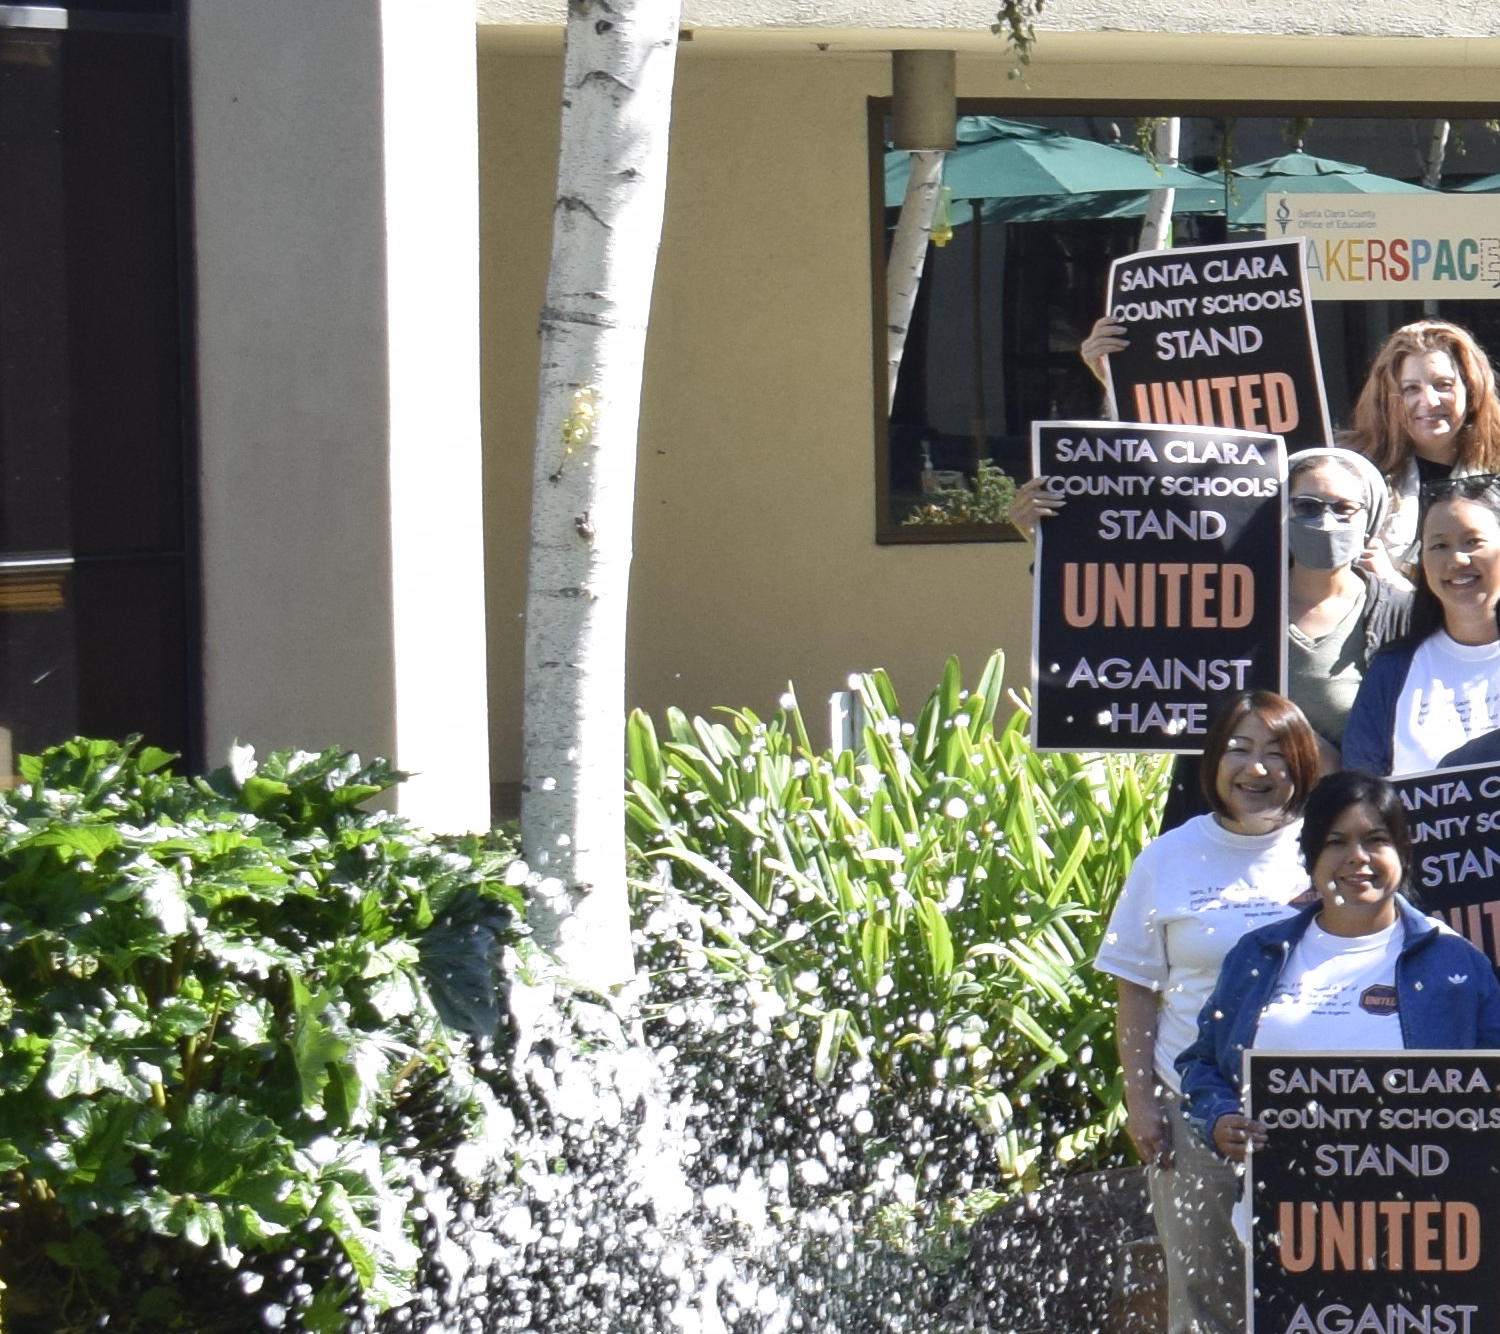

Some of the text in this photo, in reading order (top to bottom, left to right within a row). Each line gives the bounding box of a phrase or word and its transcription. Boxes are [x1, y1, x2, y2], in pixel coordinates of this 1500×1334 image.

[1121, 254, 1287, 292] SANTA CLARA
[1306, 238, 1500, 282] AKERSPACE
[1114, 288, 1302, 322] COUNTY SCHOOLS
[1157, 326, 1263, 360] STAND
[1056, 438, 1265, 465] SANTA CLARA
[1047, 476, 1278, 497] COUNTY SCHOOLS
[1098, 510, 1226, 541] STAND
[1063, 563, 1254, 628] UNITED
[1066, 658, 1252, 690] AGAINST
[1112, 703, 1207, 735] HATE
[1399, 783, 1472, 811] ANTA
[1268, 1069, 1490, 1094] SANTA CLARA
[1259, 1109, 1371, 1129] COUNTY
[1315, 1145, 1449, 1176] STAND
[1279, 1201, 1480, 1271] UNITED
